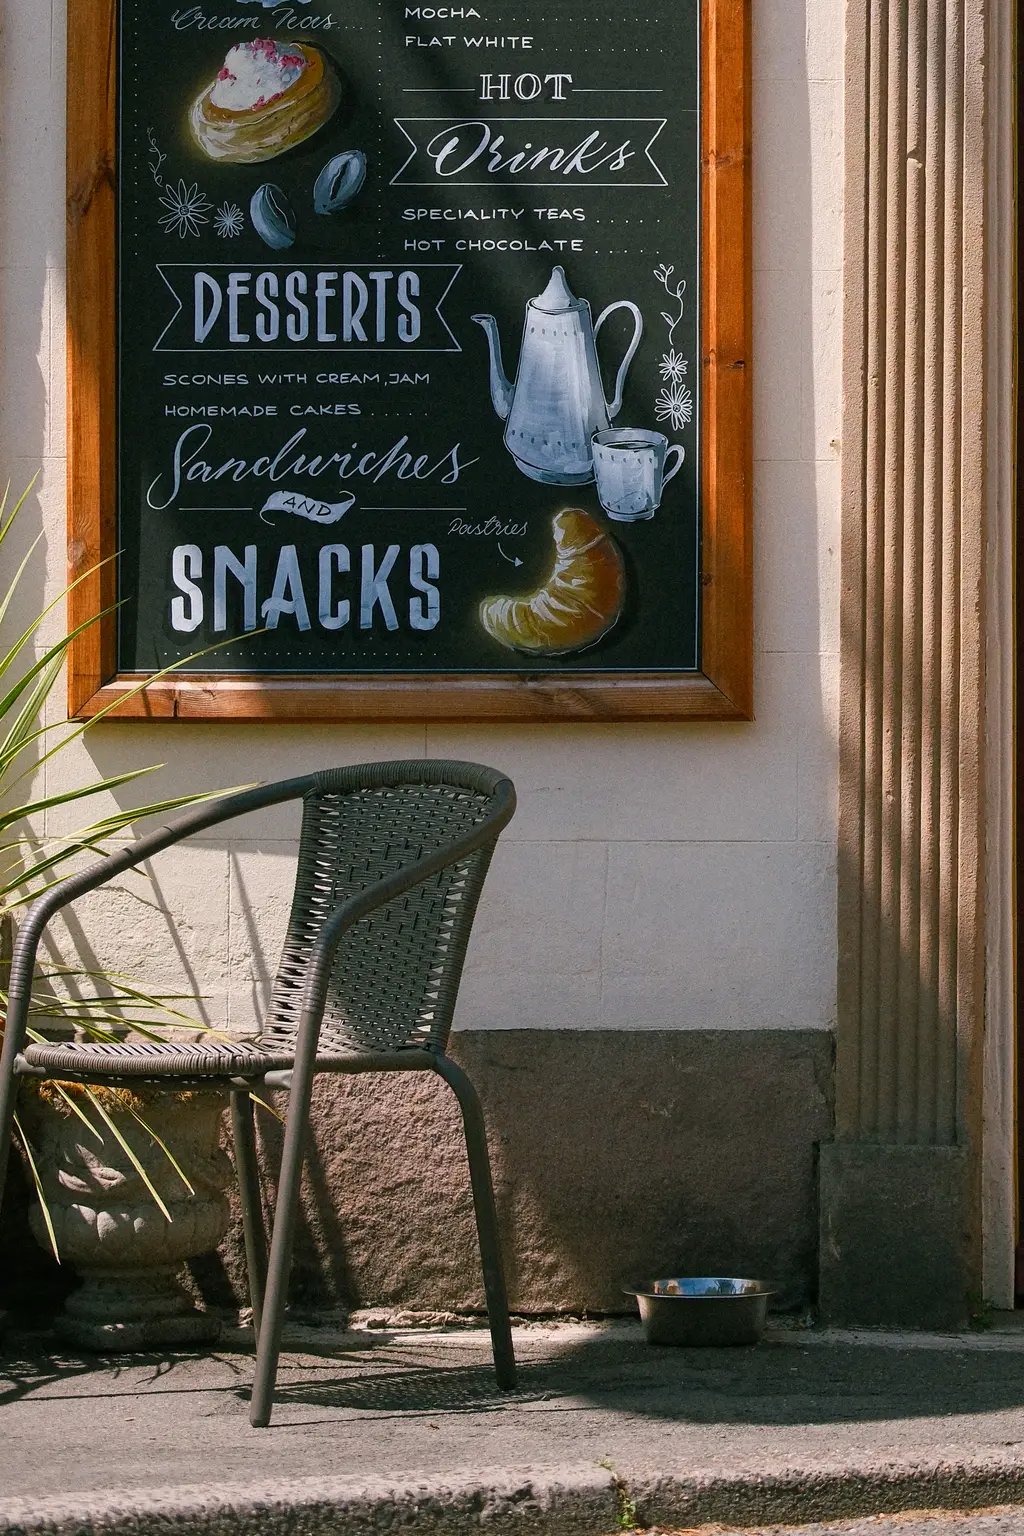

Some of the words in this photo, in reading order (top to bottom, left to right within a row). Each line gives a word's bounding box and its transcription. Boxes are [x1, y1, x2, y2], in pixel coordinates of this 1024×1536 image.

[170, 6, 261, 30] Cream
[271, 7, 337, 30] Teas
[405, 7, 481, 19] MOCHA
[405, 36, 456, 48] FLAT
[463, 36, 534, 49] WHITE
[479, 72, 573, 100] HOT
[426, 122, 635, 176] Drinks
[401, 208, 525, 221] SPECIALITY
[533, 208, 586, 221] TEAS
[404, 239, 445, 252] HOT
[455, 239, 584, 252] CHOCOLATE
[194, 271, 421, 343] DESSERTS
[162, 374, 249, 386] SCONES
[257, 374, 308, 385] WITH
[165, 405, 278, 417] HOMEMADE
[290, 403, 362, 416] CAKES
[147, 423, 480, 510] Sandwiches
[283, 496, 332, 517] AND
[448, 515, 528, 536] Pastries
[171, 543, 440, 632] SNACKS
